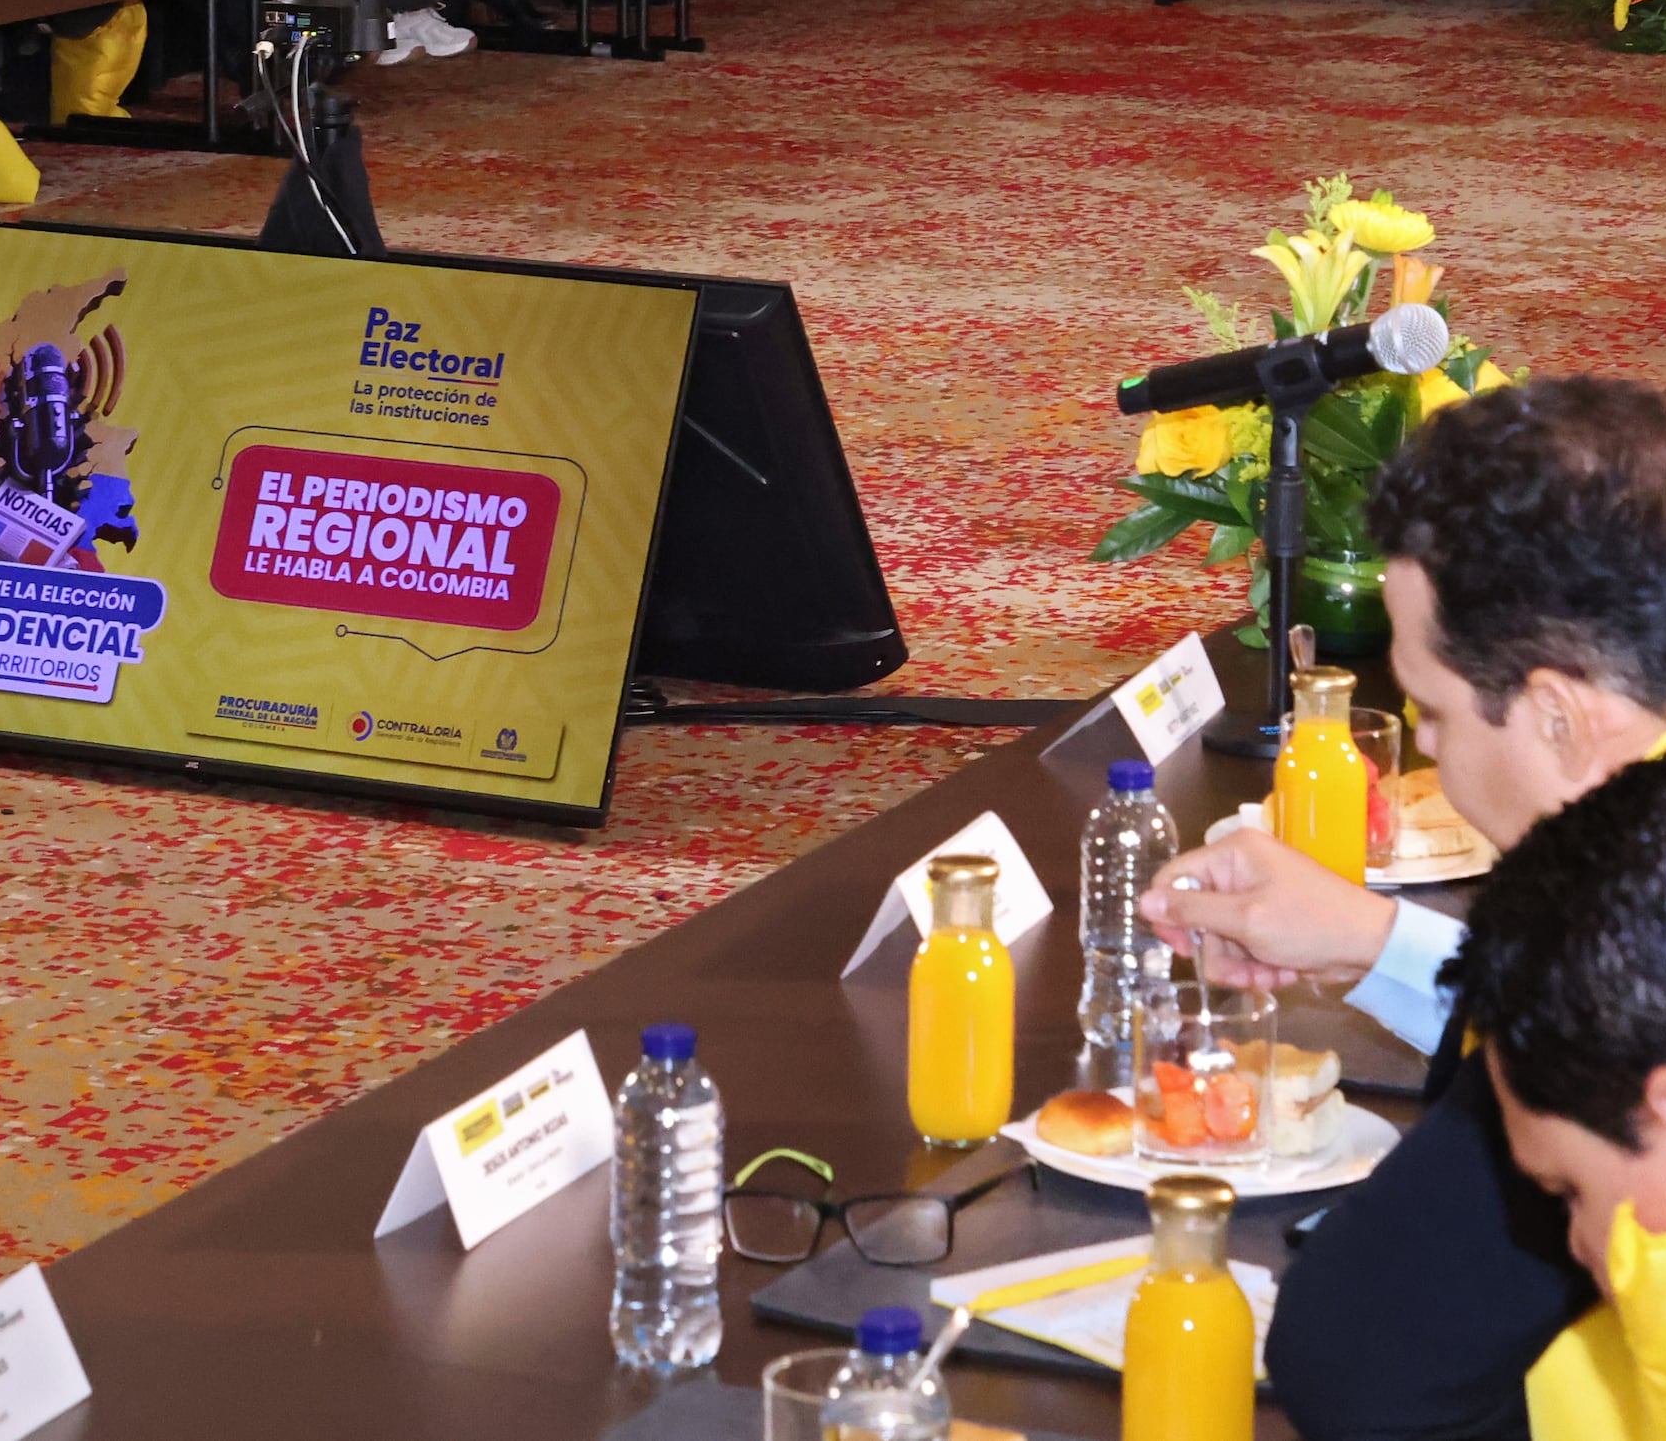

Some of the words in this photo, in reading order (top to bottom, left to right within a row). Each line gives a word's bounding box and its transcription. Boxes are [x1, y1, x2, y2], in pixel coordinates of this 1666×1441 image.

[365, 307, 421, 343] Paz
[359, 341, 505, 379] Electoral
[354, 380, 373, 396] La
[377, 383, 470, 406] protección
[475, 391, 497, 408] de
[350, 399, 374, 415] las
[378, 401, 489, 426] instituciones
[258, 470, 295, 504] EL
[301, 475, 527, 528] PERIODISMO
[249, 503, 516, 575] REGIONAL
[244, 550, 271, 574] LE
[273, 553, 352, 583] HABLA
[356, 564, 375, 586] A
[379, 566, 510, 601] COLOMBIA
[14, 581, 37, 601] LA
[41, 585, 135, 612] ELECCIÓN
[217, 707, 254, 719] GENERAL
[218, 695, 318, 718] PROCURADURÍA
[377, 719, 462, 739] CONTRALORÍA
